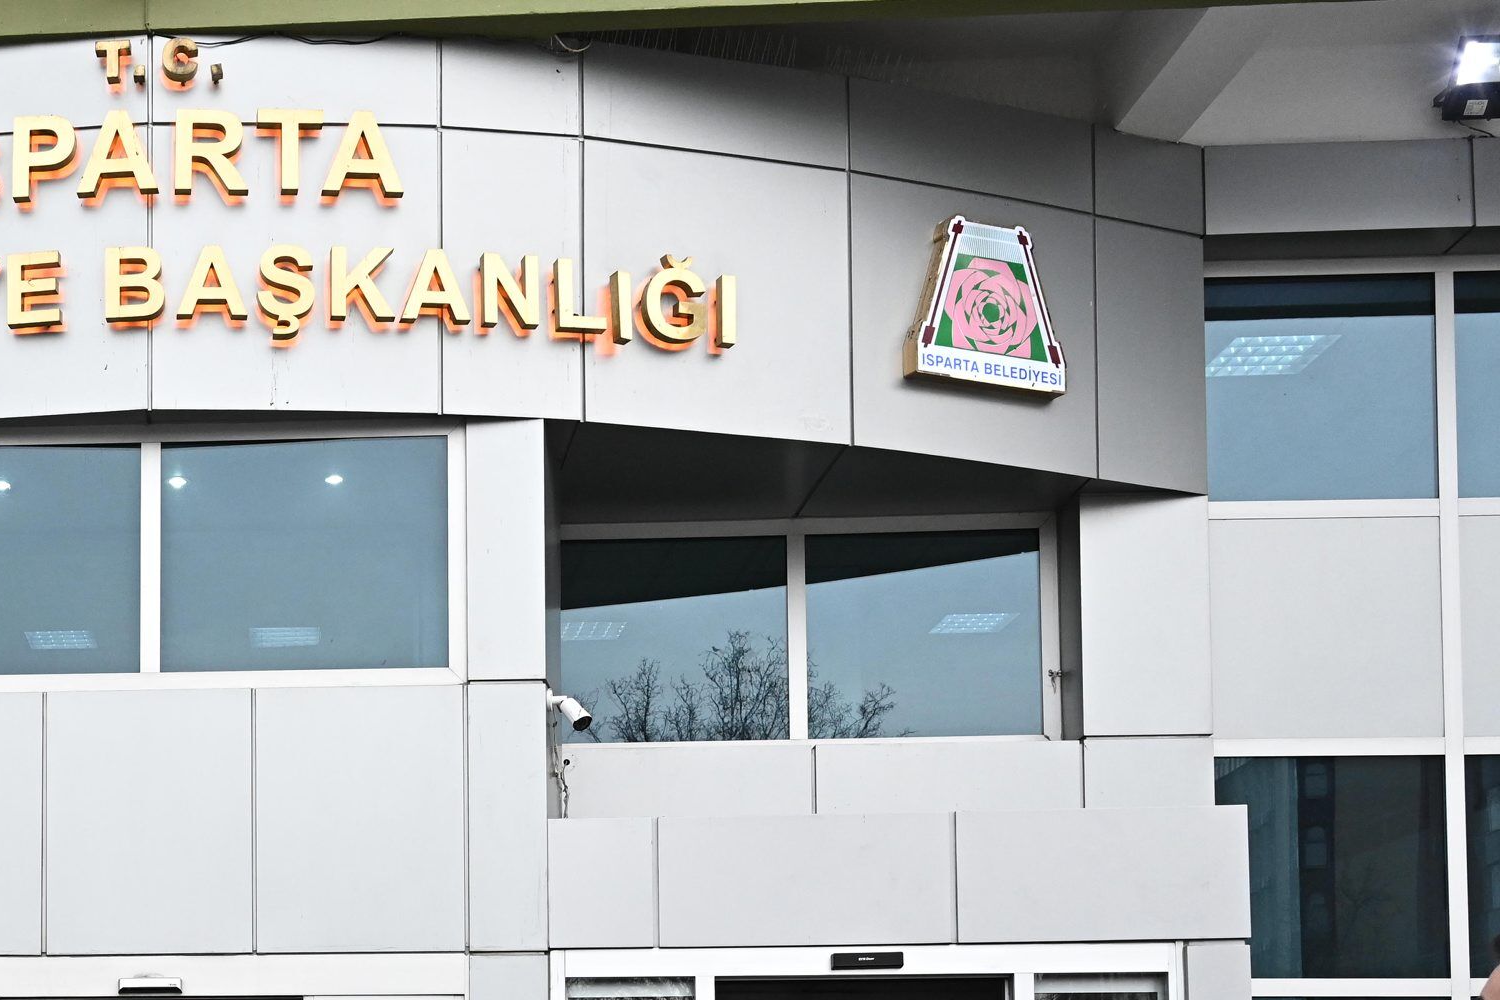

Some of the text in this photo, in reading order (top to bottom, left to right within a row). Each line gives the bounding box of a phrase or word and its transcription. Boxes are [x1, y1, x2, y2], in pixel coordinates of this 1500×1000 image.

[105, 244, 736, 348] BAŞKANLIĞI
[922, 353, 1062, 386] ISPARTA BELEDİYESİ
